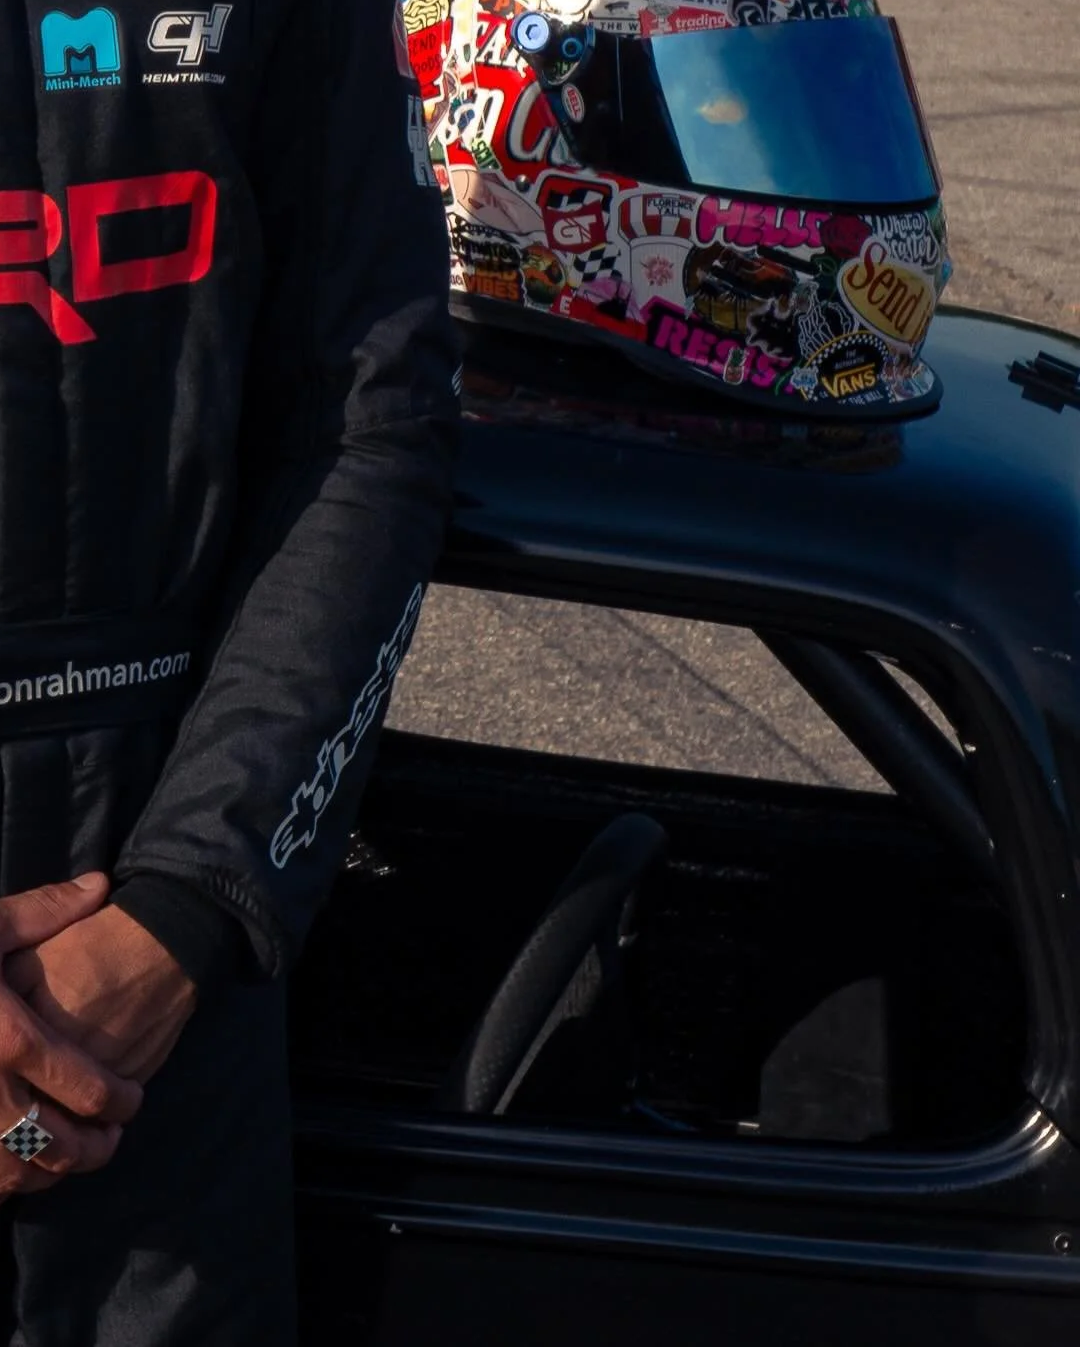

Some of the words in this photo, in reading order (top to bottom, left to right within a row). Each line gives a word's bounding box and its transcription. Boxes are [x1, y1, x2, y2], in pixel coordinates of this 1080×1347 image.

[675, 12, 727, 28] trading
[45, 73, 122, 92] Mini-Merch
[552, 214, 597, 246] GT
[847, 242, 924, 335] Send
[821, 362, 876, 398] VANS
